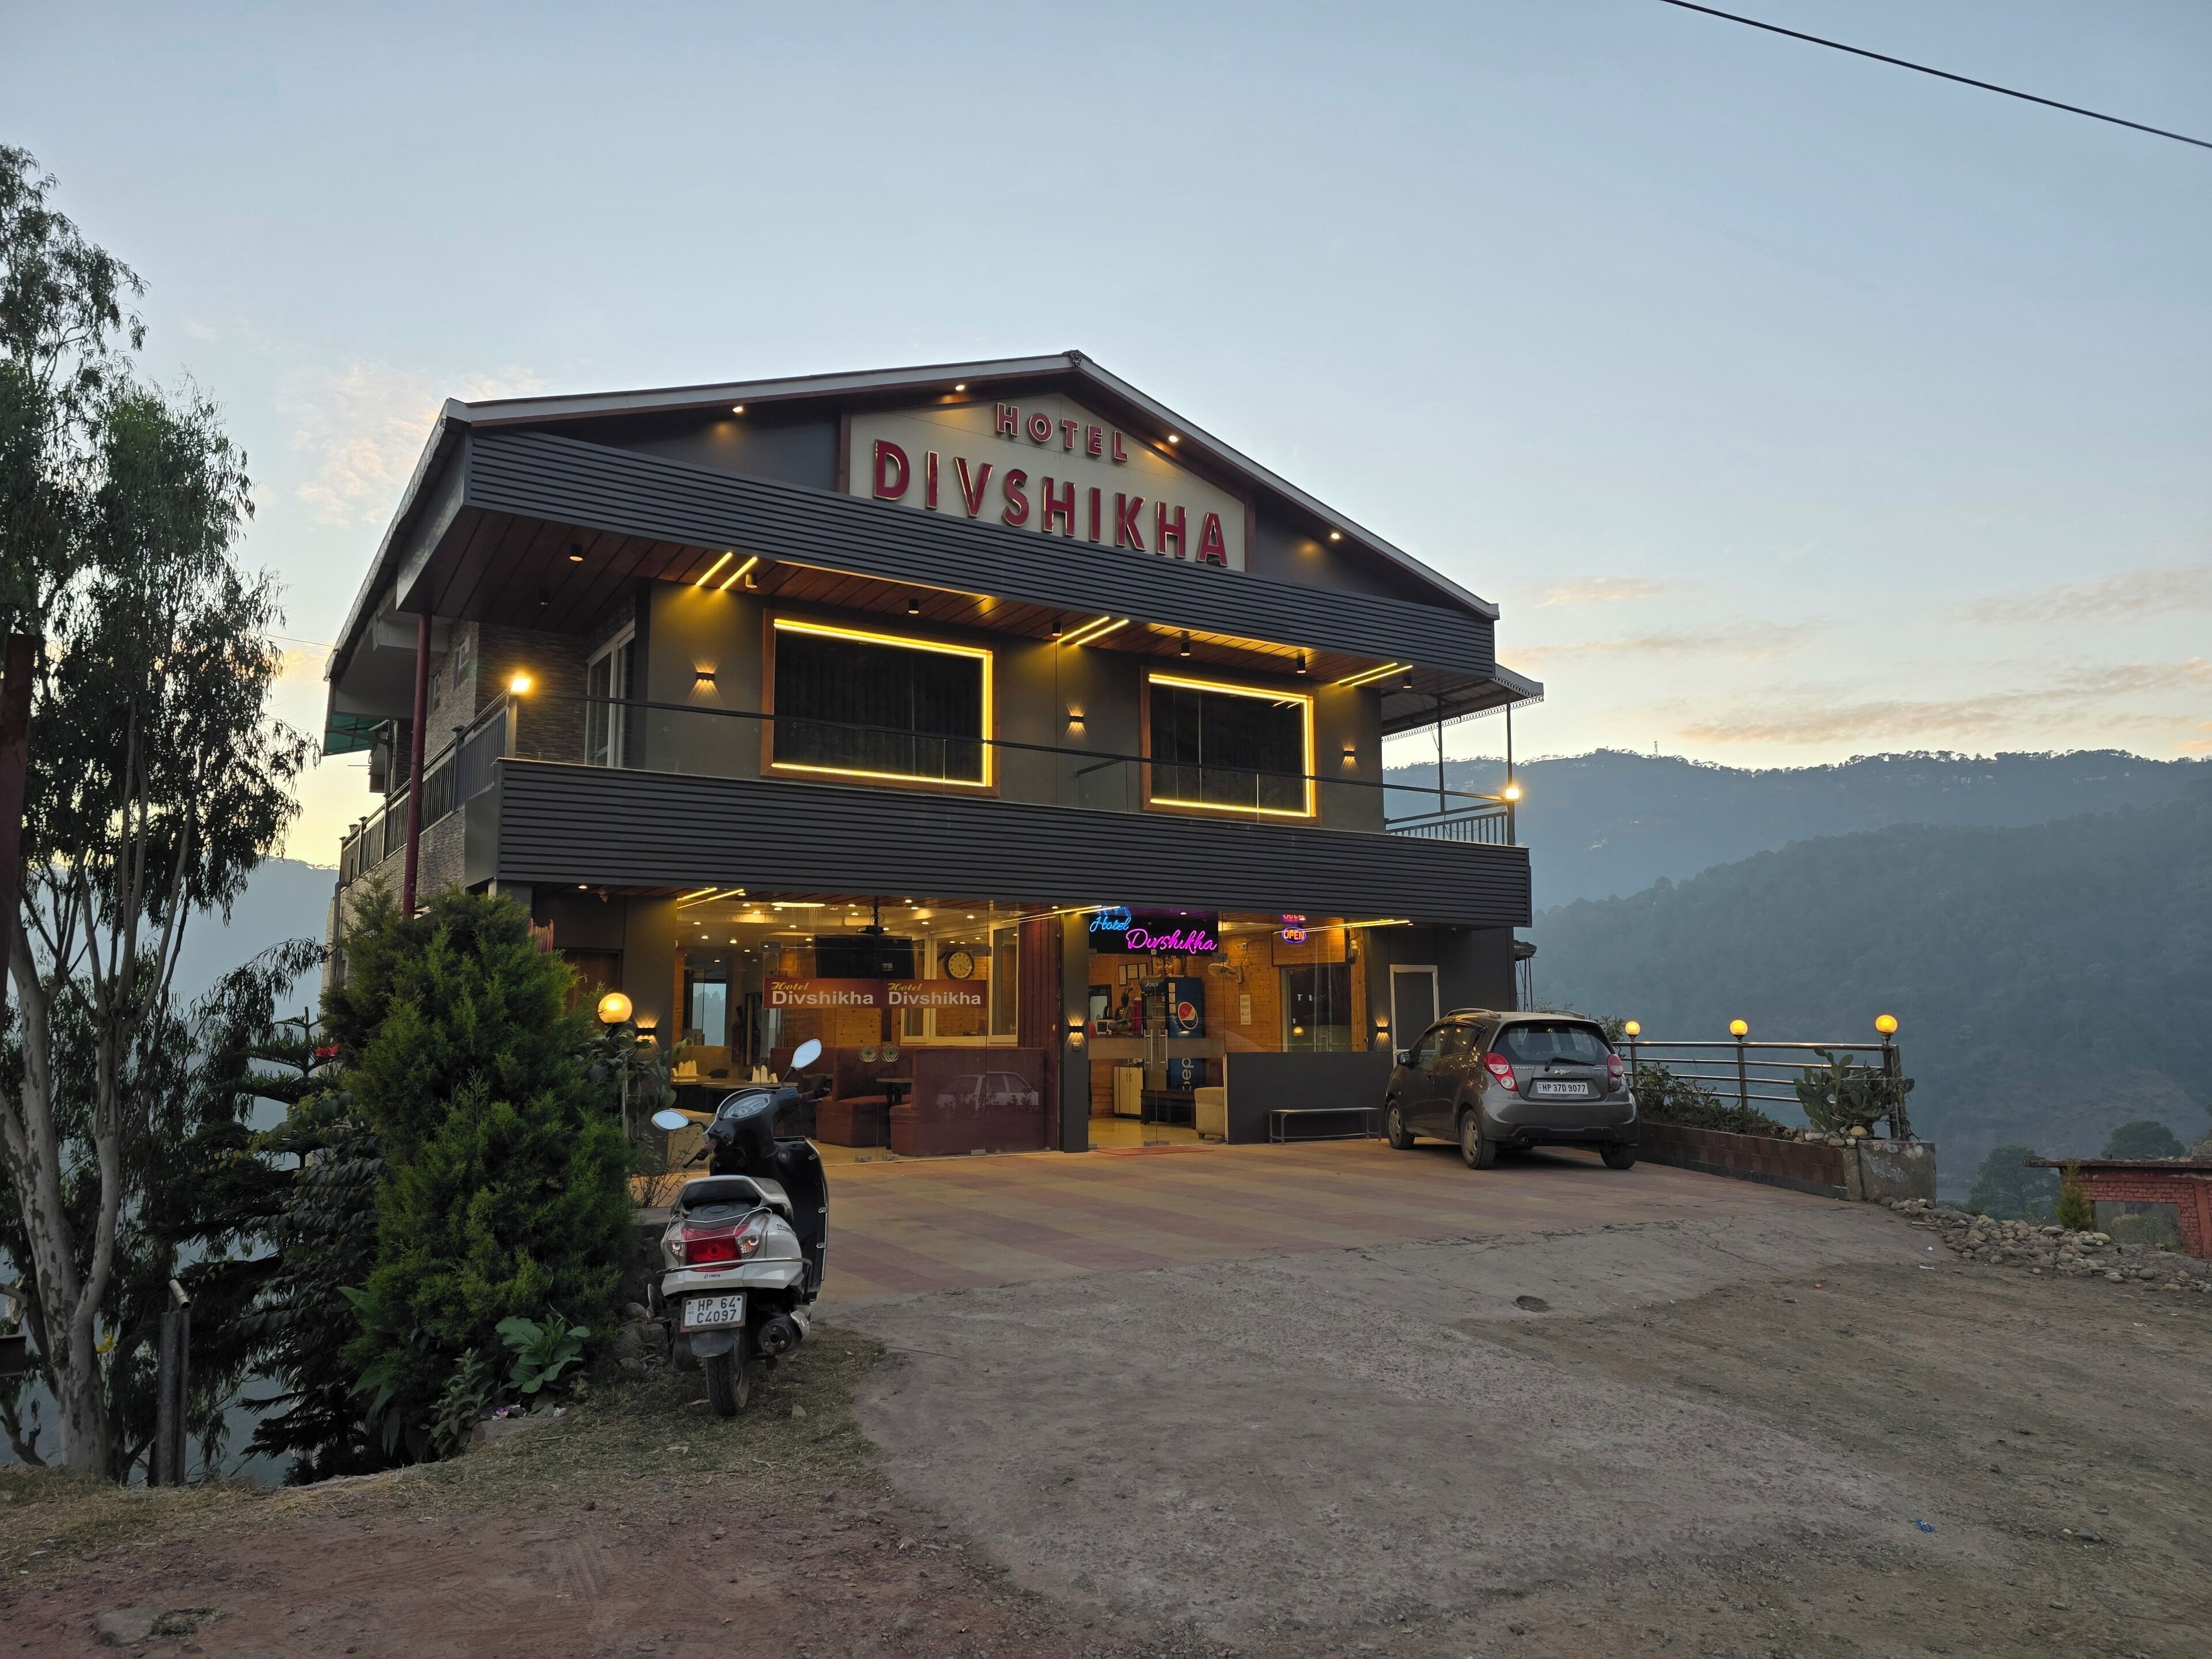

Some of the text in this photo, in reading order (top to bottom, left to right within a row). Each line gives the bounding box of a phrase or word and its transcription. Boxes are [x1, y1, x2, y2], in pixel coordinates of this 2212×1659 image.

[997, 402, 1128, 462] HOTEL
[873, 439, 1228, 567] DIVSHIKHA
[1090, 916, 1131, 932] Hotel
[1283, 930, 1304, 940] OPEN
[771, 982, 809, 990] Hotel
[887, 983, 922, 991] Hotel
[772, 990, 873, 1005] Divshikha
[888, 991, 981, 1005] Divshikha
[1542, 1084, 1585, 1093] HP 37D 9077
[698, 1297, 736, 1312] HP 64
[696, 1309, 737, 1324] C4097
